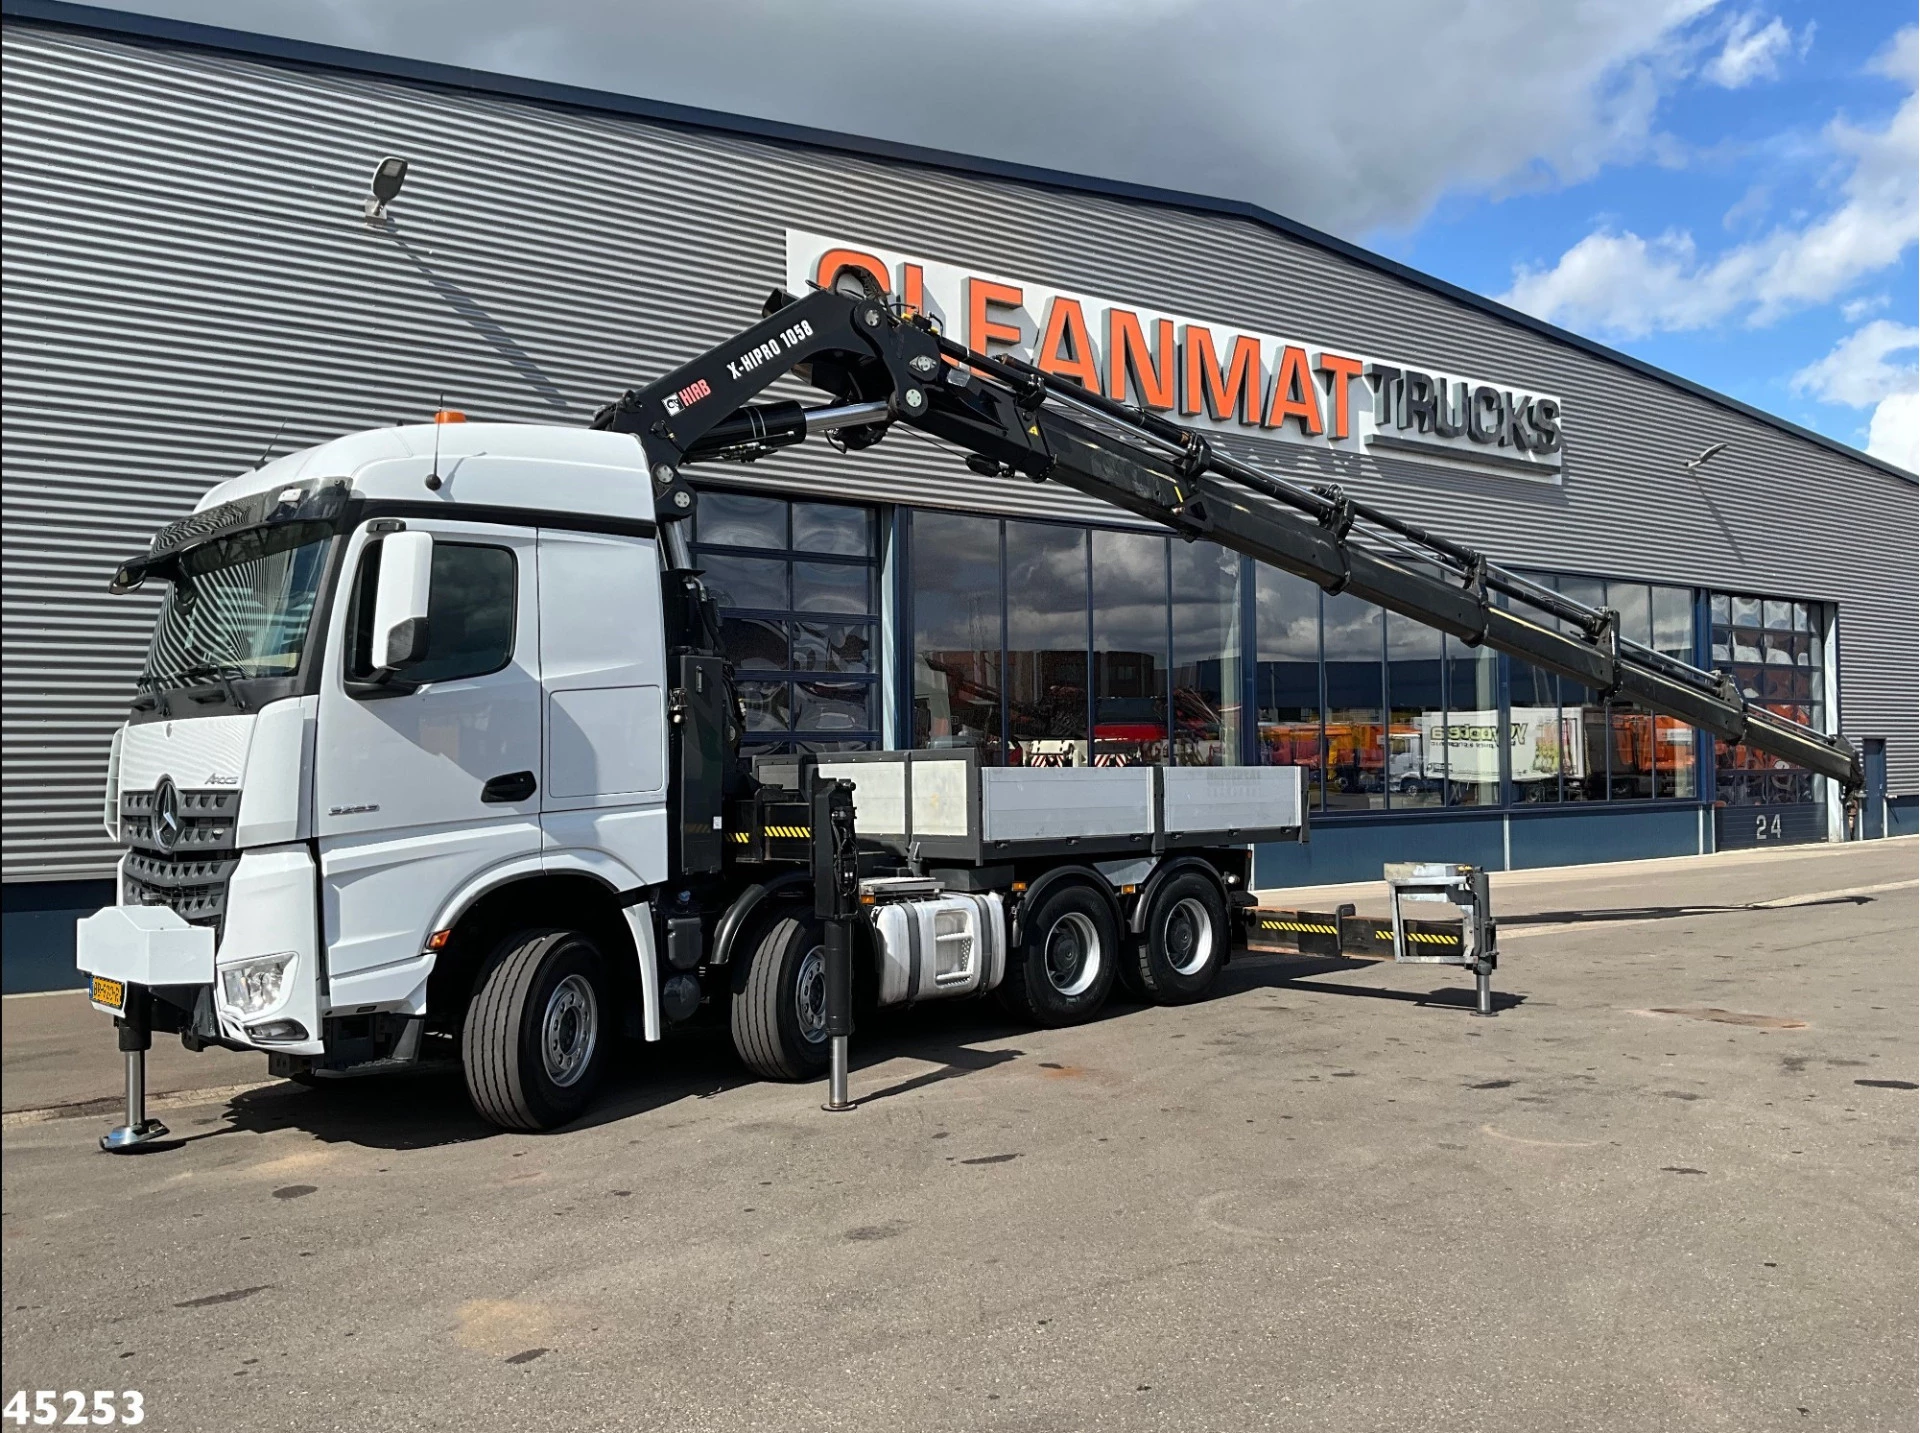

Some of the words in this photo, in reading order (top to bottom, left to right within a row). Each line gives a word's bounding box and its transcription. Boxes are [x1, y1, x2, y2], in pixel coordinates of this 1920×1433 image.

[726, 339, 781, 379] X-HIPRO
[780, 320, 813, 348] 1058
[678, 379, 711, 406] HIAB
[1365, 363, 1561, 455] TRUCKS
[1755, 814, 1782, 840] 24
